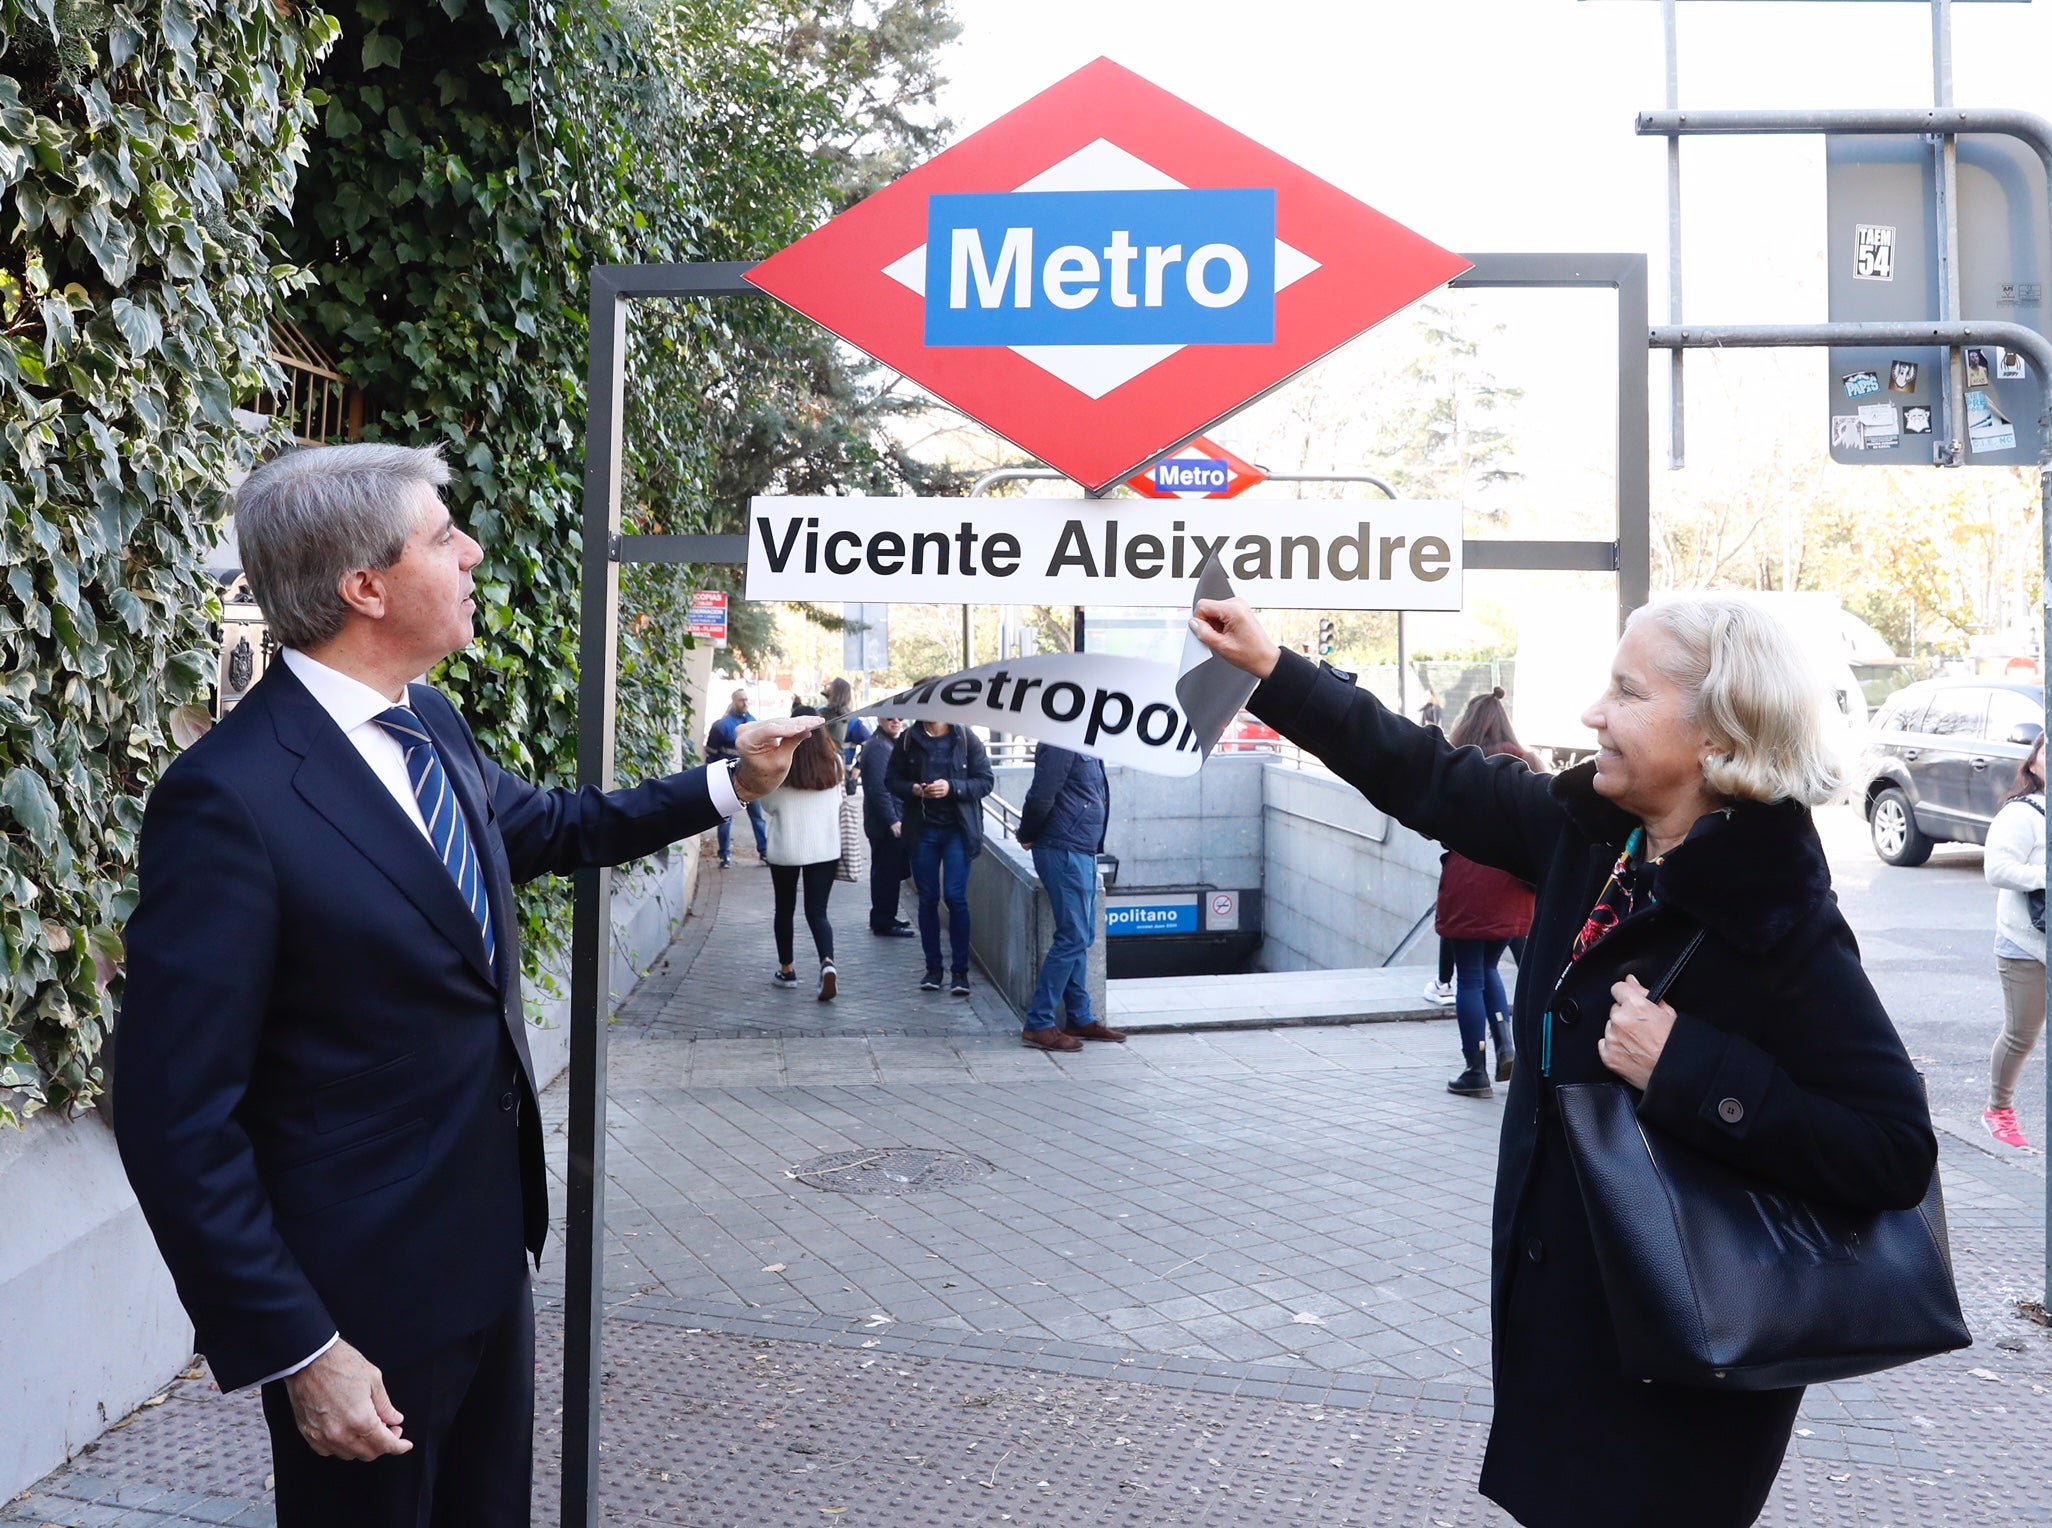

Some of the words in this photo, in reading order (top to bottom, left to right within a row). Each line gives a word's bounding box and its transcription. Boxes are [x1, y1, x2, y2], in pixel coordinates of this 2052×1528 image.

[1859, 228, 1892, 246] TAEM
[950, 227, 1249, 310] Metro
[1857, 244, 1891, 277] 54
[1159, 465, 1225, 486] Metro
[756, 516, 1022, 578] Vicente
[1045, 519, 1452, 582] Aleixandre
